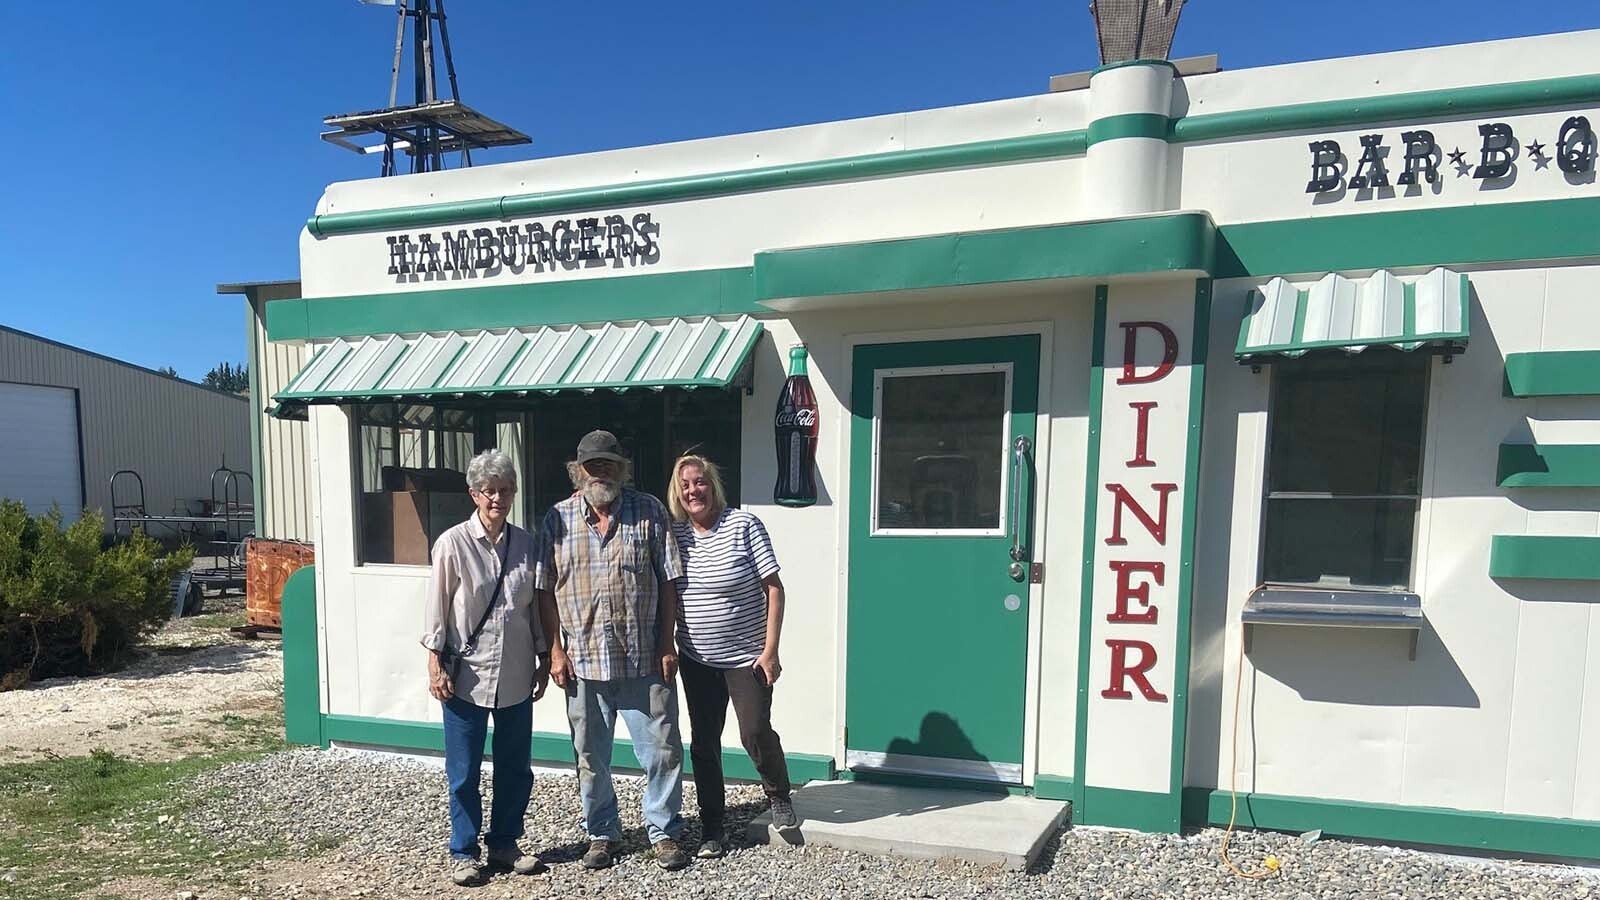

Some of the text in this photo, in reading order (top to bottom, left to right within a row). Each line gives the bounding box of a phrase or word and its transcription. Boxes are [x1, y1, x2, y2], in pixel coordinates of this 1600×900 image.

[1305, 129, 1437, 193] BAR
[386, 212, 653, 276] HAMBURGERS
[1101, 320, 1179, 703] DINER
